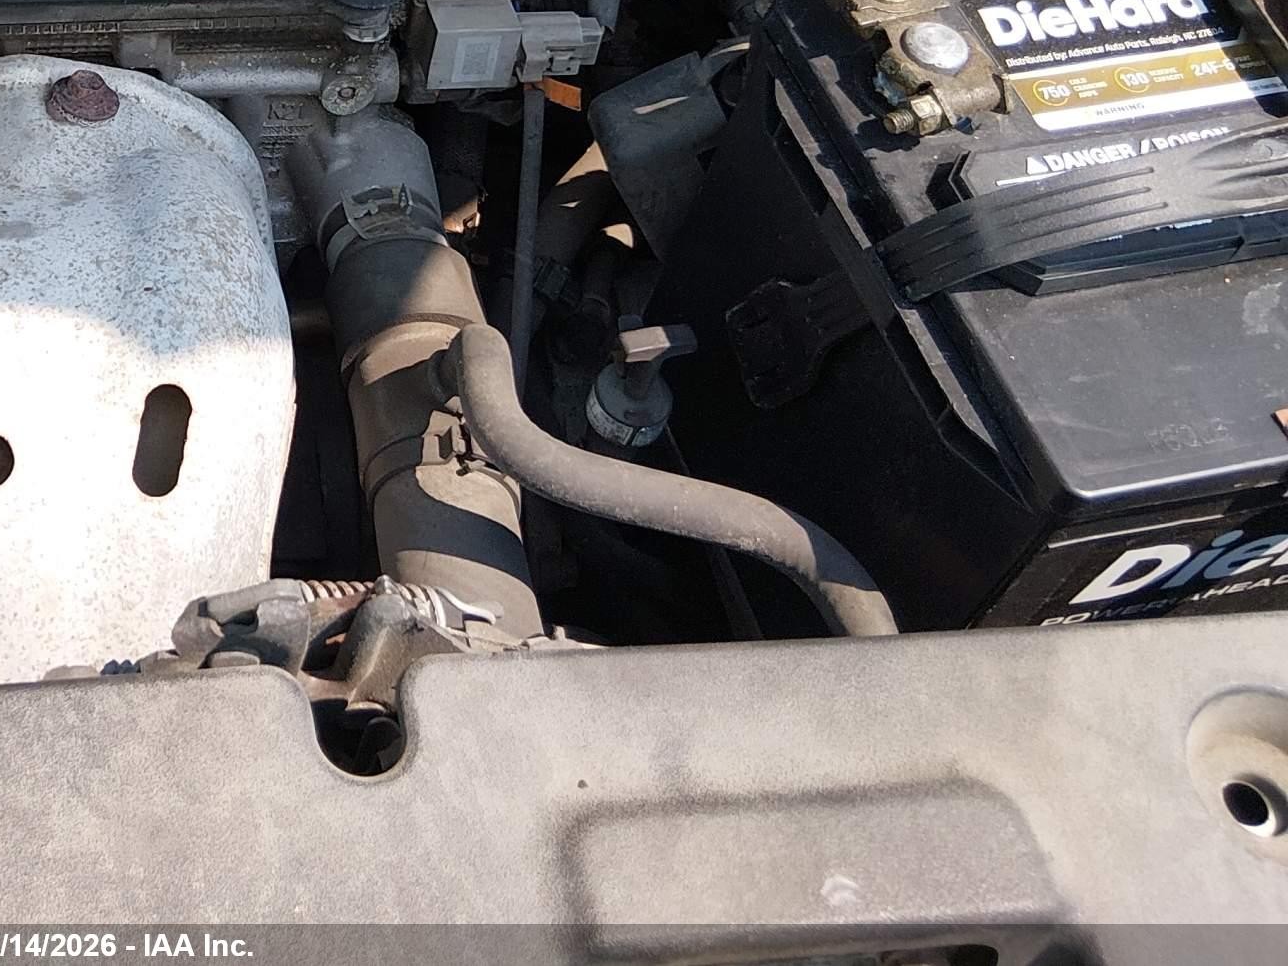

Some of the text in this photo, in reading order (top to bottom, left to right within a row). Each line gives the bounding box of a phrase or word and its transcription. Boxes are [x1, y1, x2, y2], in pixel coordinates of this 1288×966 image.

[1005, 52, 1053, 67] Distributed
[1068, 45, 1104, 58] Advance
[1104, 42, 1125, 52] Auto
[1183, 31, 1197, 41] NC
[1038, 84, 1071, 101] 750
[1120, 71, 1150, 87] 130
[1046, 143, 1139, 171] DANGER
[1068, 529, 1288, 605] Die
